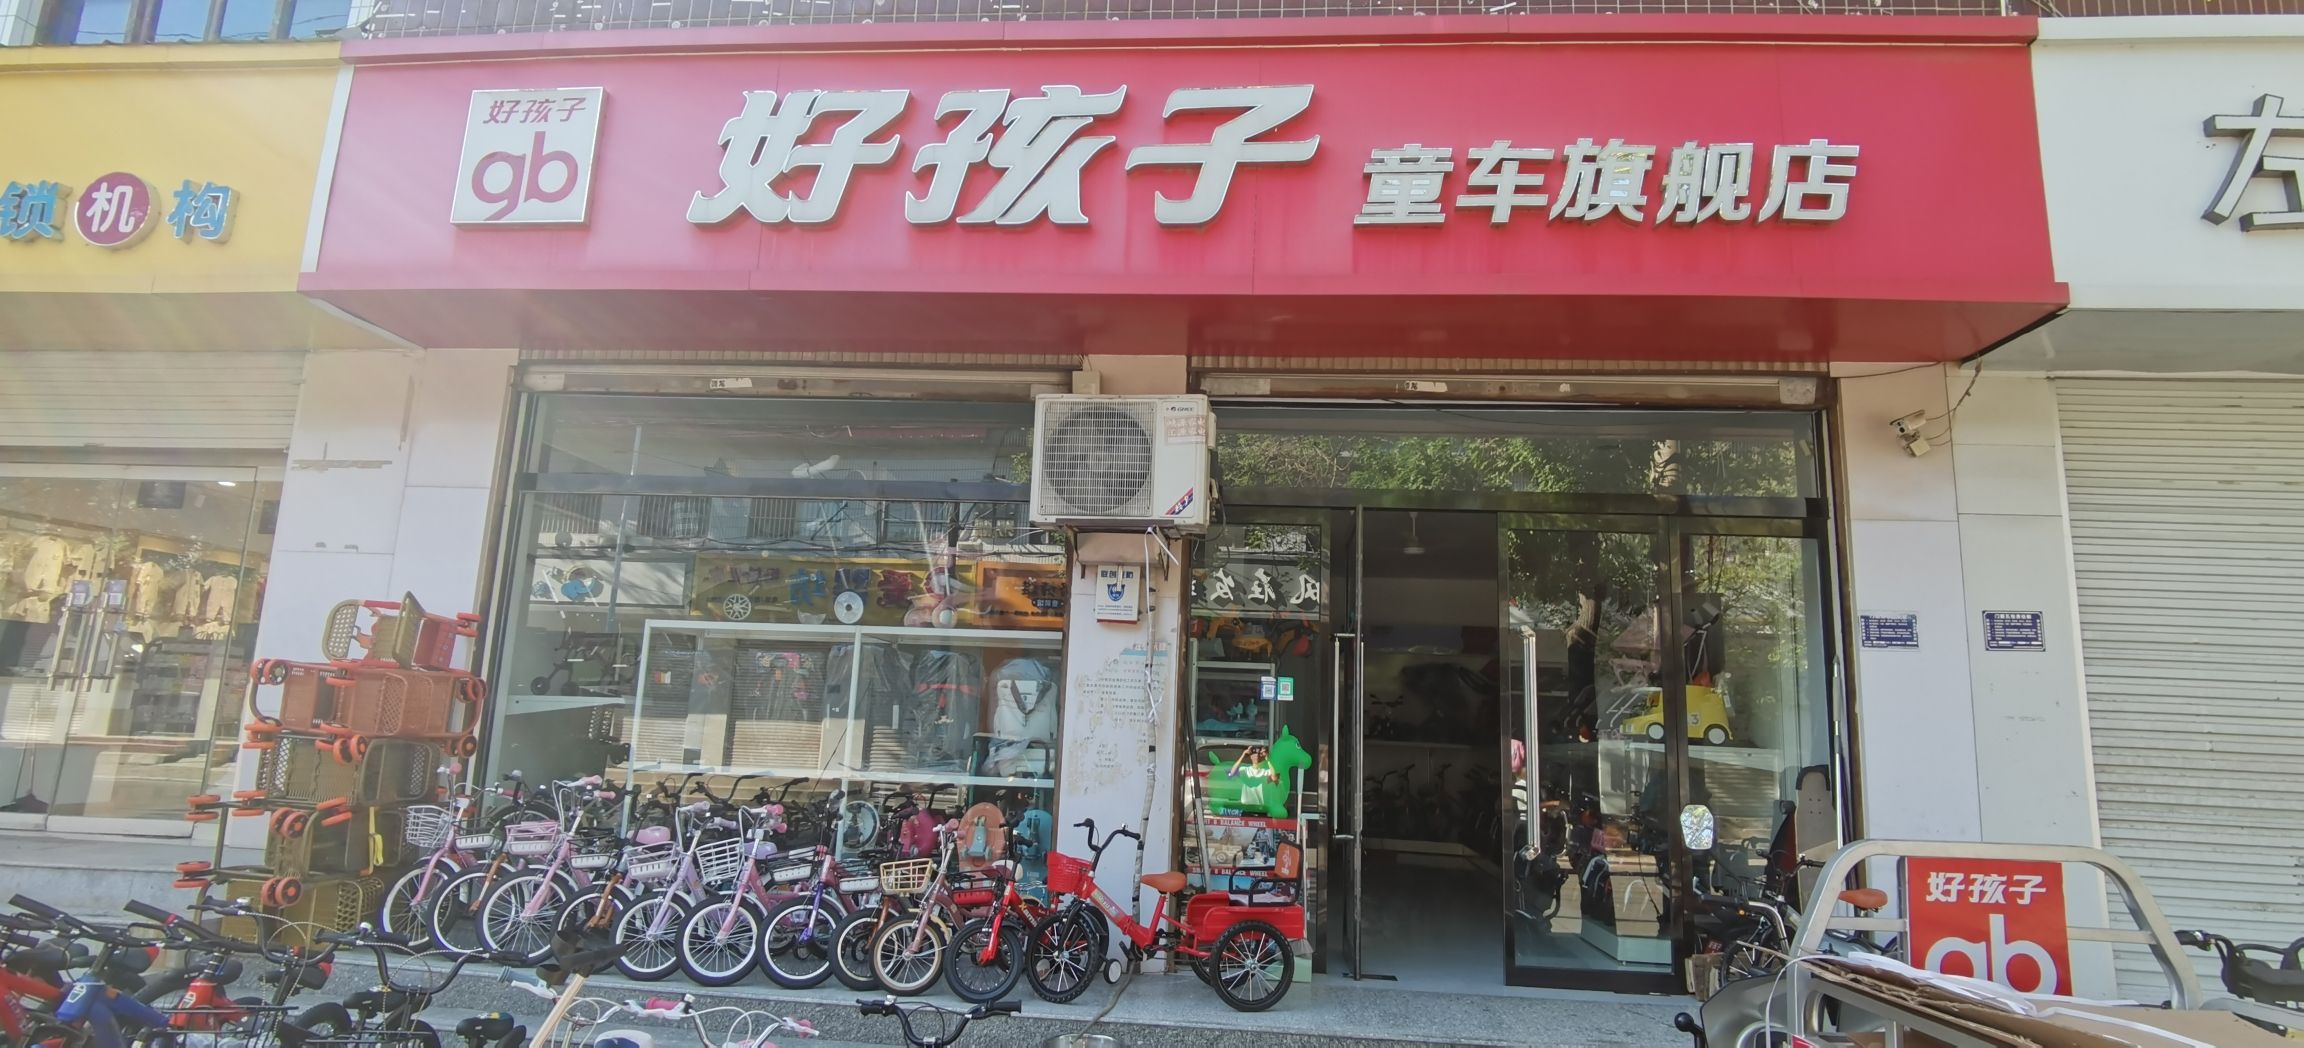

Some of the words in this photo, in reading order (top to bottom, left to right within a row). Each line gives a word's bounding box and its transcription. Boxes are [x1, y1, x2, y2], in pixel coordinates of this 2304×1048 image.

[483, 97, 587, 125] 好孩子
[471, 130, 579, 222] gb
[686, 84, 1321, 226] 好孩子
[1353, 137, 1860, 228] 童车旗舰店
[2201, 93, 2304, 232] 左
[0, 179, 236, 243] 锁机构
[1248, 820, 1266, 828] WHEEL
[1926, 871, 2047, 906] 好孩子
